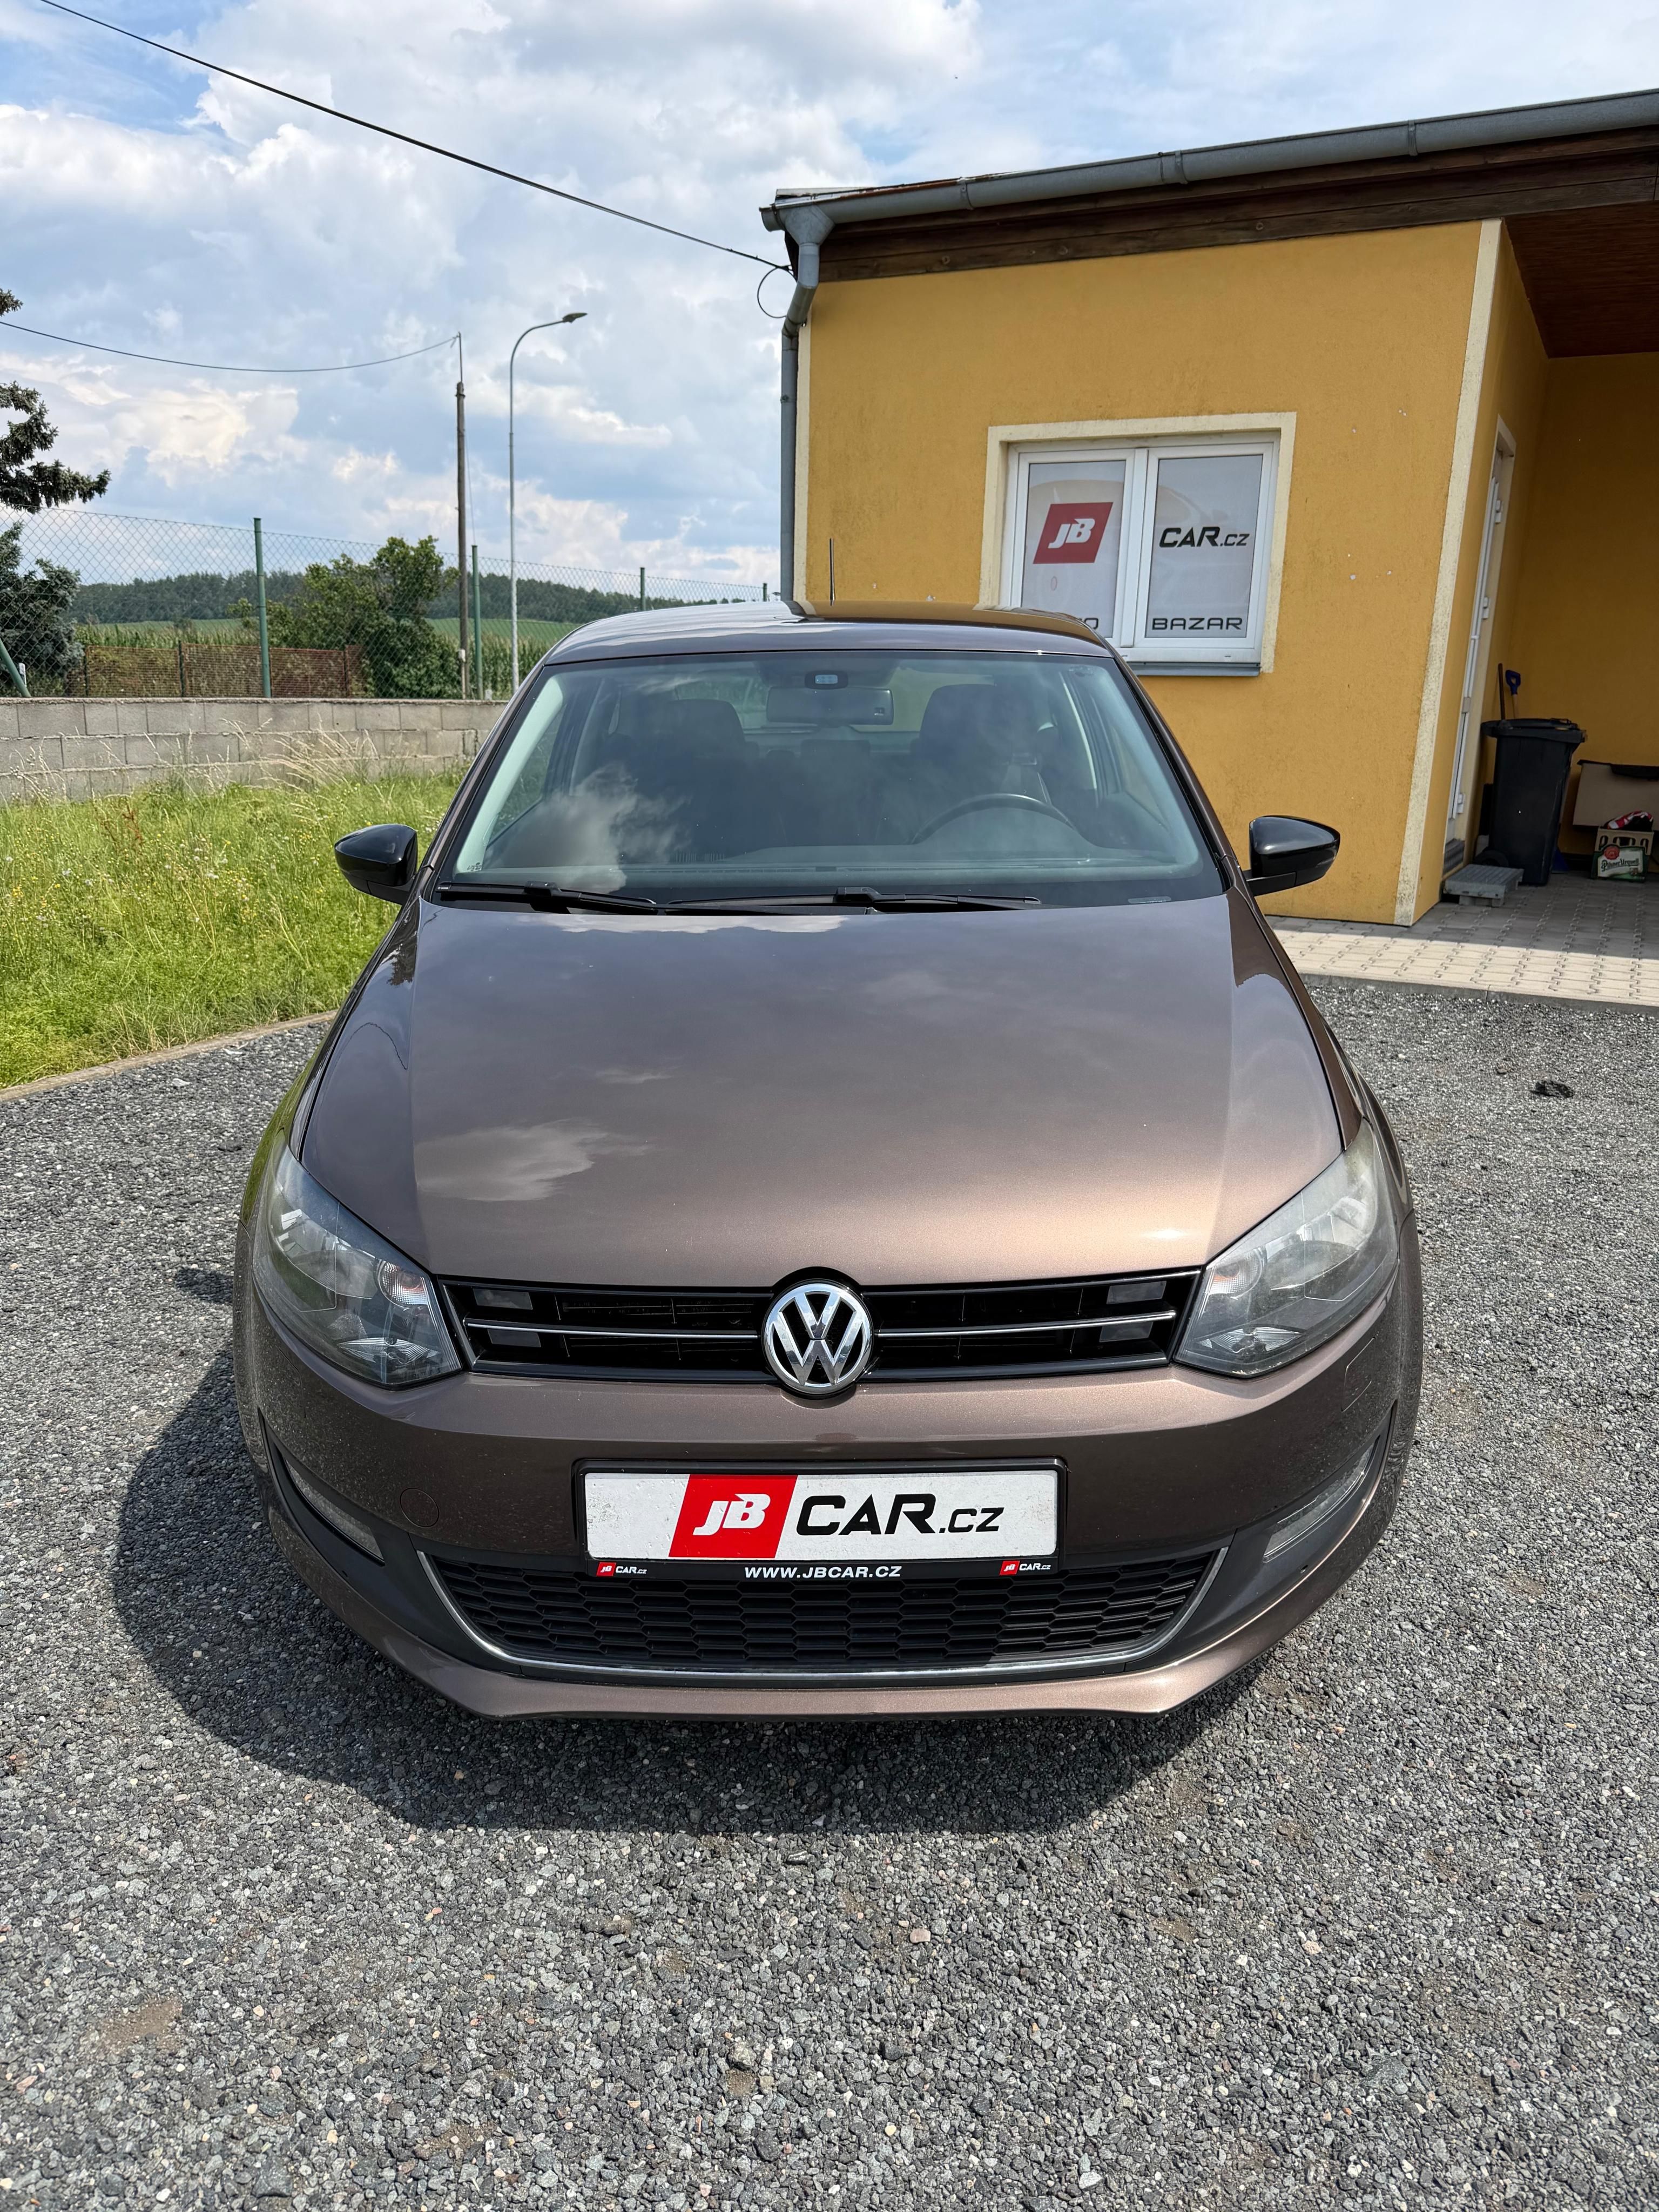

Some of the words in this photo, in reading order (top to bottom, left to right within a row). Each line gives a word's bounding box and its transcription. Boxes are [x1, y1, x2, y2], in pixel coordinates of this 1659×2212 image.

[1048, 518, 1096, 549] JB
[1152, 617, 1243, 631] BAZAR
[692, 1493, 771, 1536] JB
[745, 1564, 902, 1579] WWW.JBCAR.CZ
